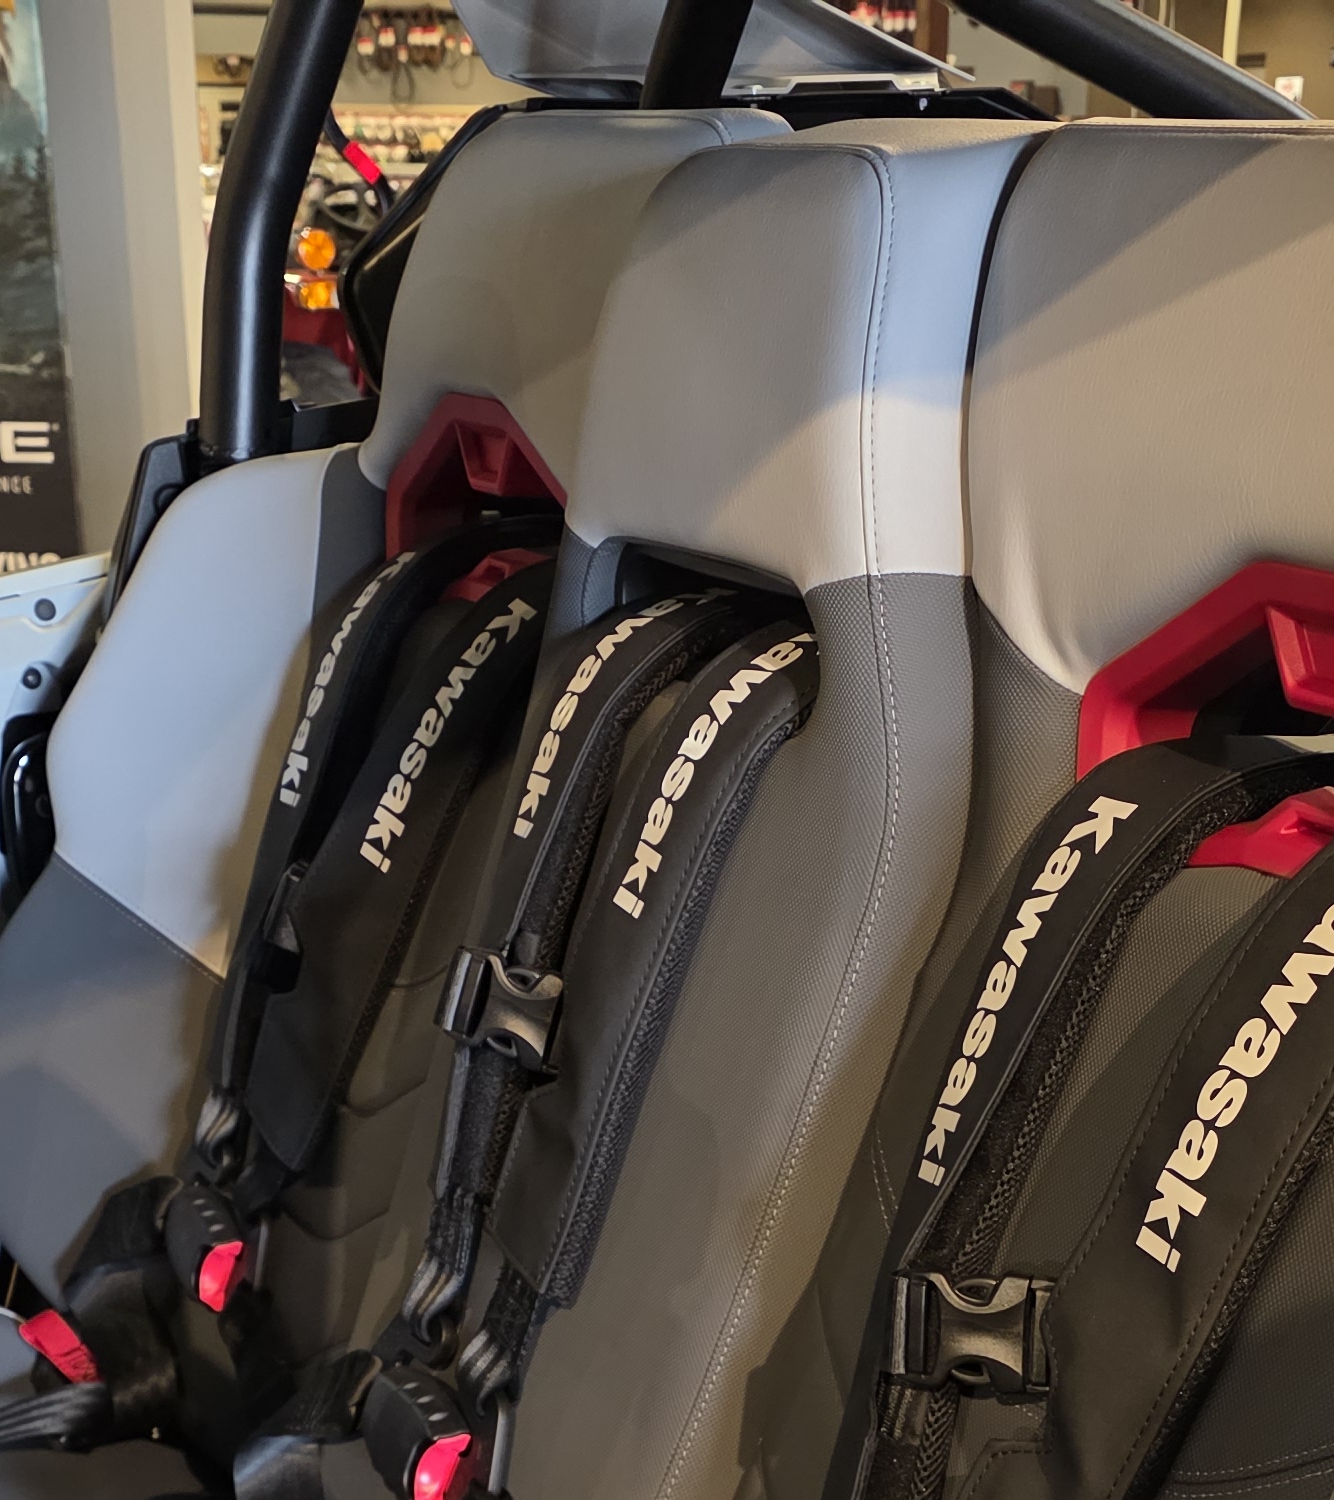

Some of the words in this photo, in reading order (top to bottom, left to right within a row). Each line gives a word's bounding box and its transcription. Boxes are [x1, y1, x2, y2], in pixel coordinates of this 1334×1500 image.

[279, 551, 416, 808] Kawasaki
[359, 598, 538, 874] Kawasaki
[917, 796, 1138, 1187] Kawasaki
